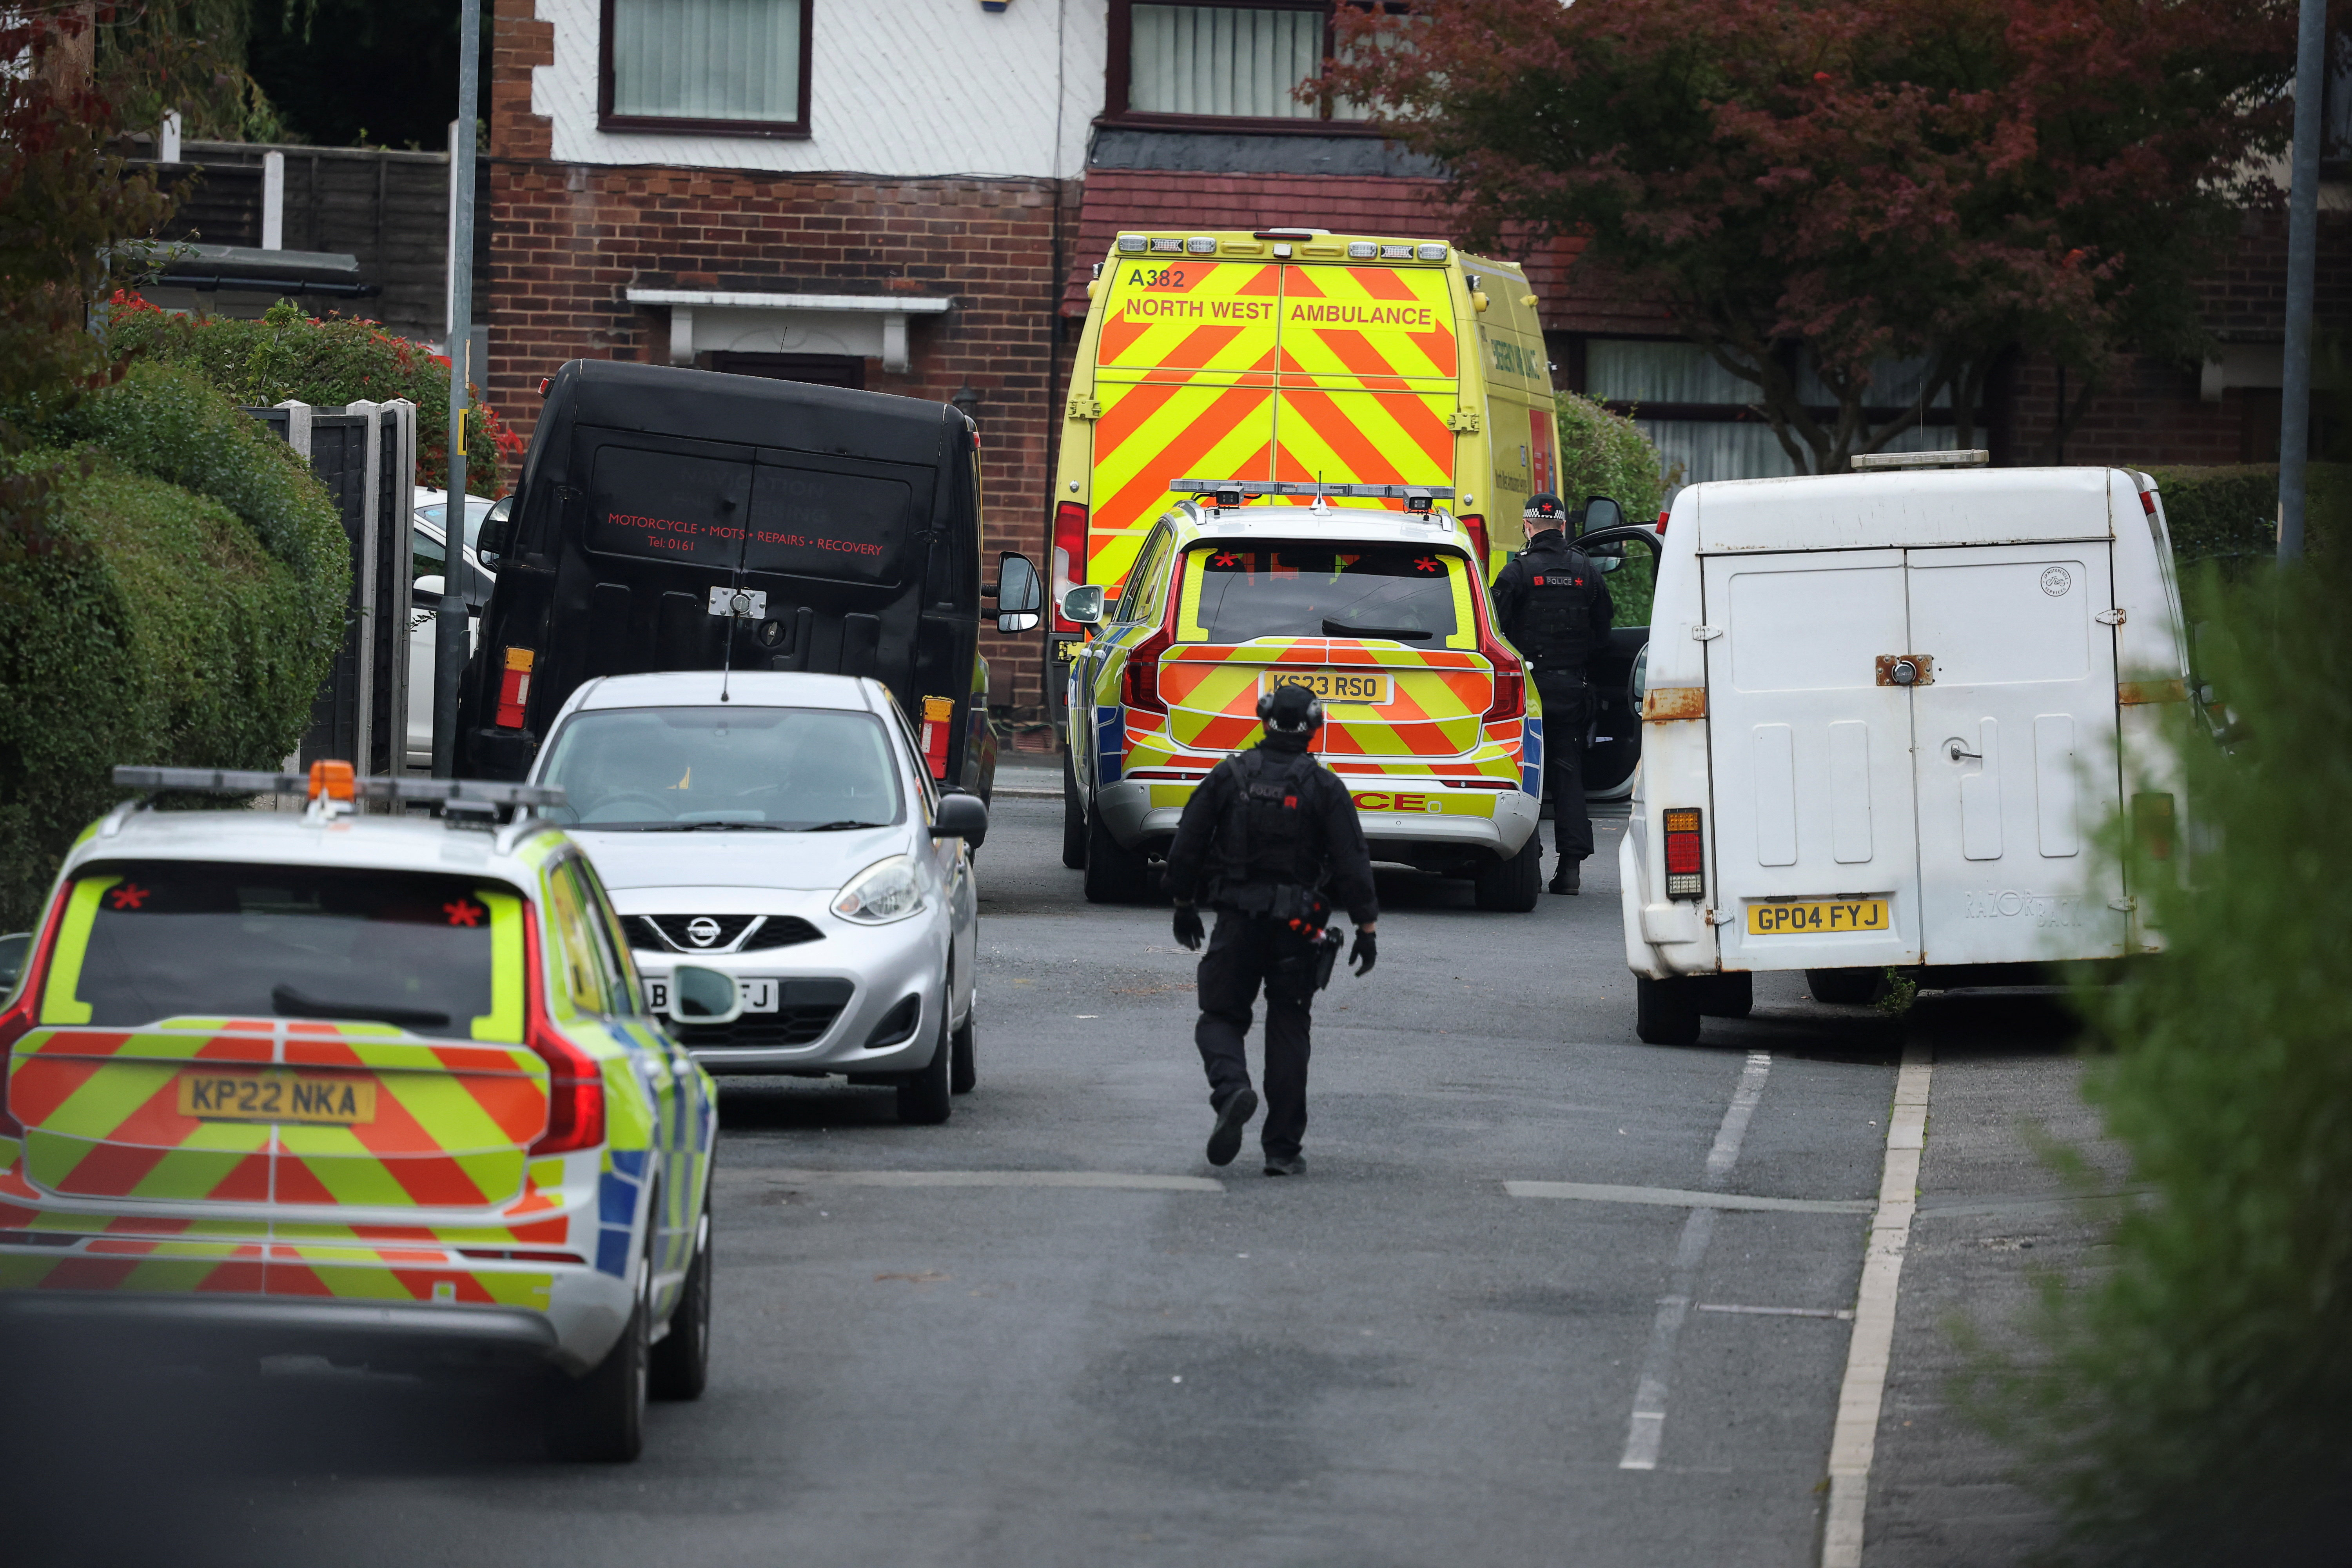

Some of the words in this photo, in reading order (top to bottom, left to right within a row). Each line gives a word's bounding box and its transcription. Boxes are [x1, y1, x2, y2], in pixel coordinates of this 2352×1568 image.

[1129, 269, 1184, 287] A382
[1127, 299, 1203, 317] NORTH
[1211, 302, 1274, 319] WEST
[1291, 305, 1431, 325] AMBULANCE
[608, 513, 698, 534] MOTORCYCLE
[710, 526, 745, 540] MOTS
[757, 531, 805, 547] REPAIRS
[817, 538, 883, 556] RECOVERY
[648, 536, 666, 548] Tel:
[668, 539, 694, 551] 0161
[2047, 569, 2068, 580] MOTORCYCLE
[1273, 674, 1328, 695] KS23
[1335, 677, 1376, 697] RSO
[1758, 907, 1823, 930] GP04
[1830, 904, 1878, 927] FYJ
[193, 1079, 281, 1112] KP22
[292, 1083, 357, 1116] NKA
